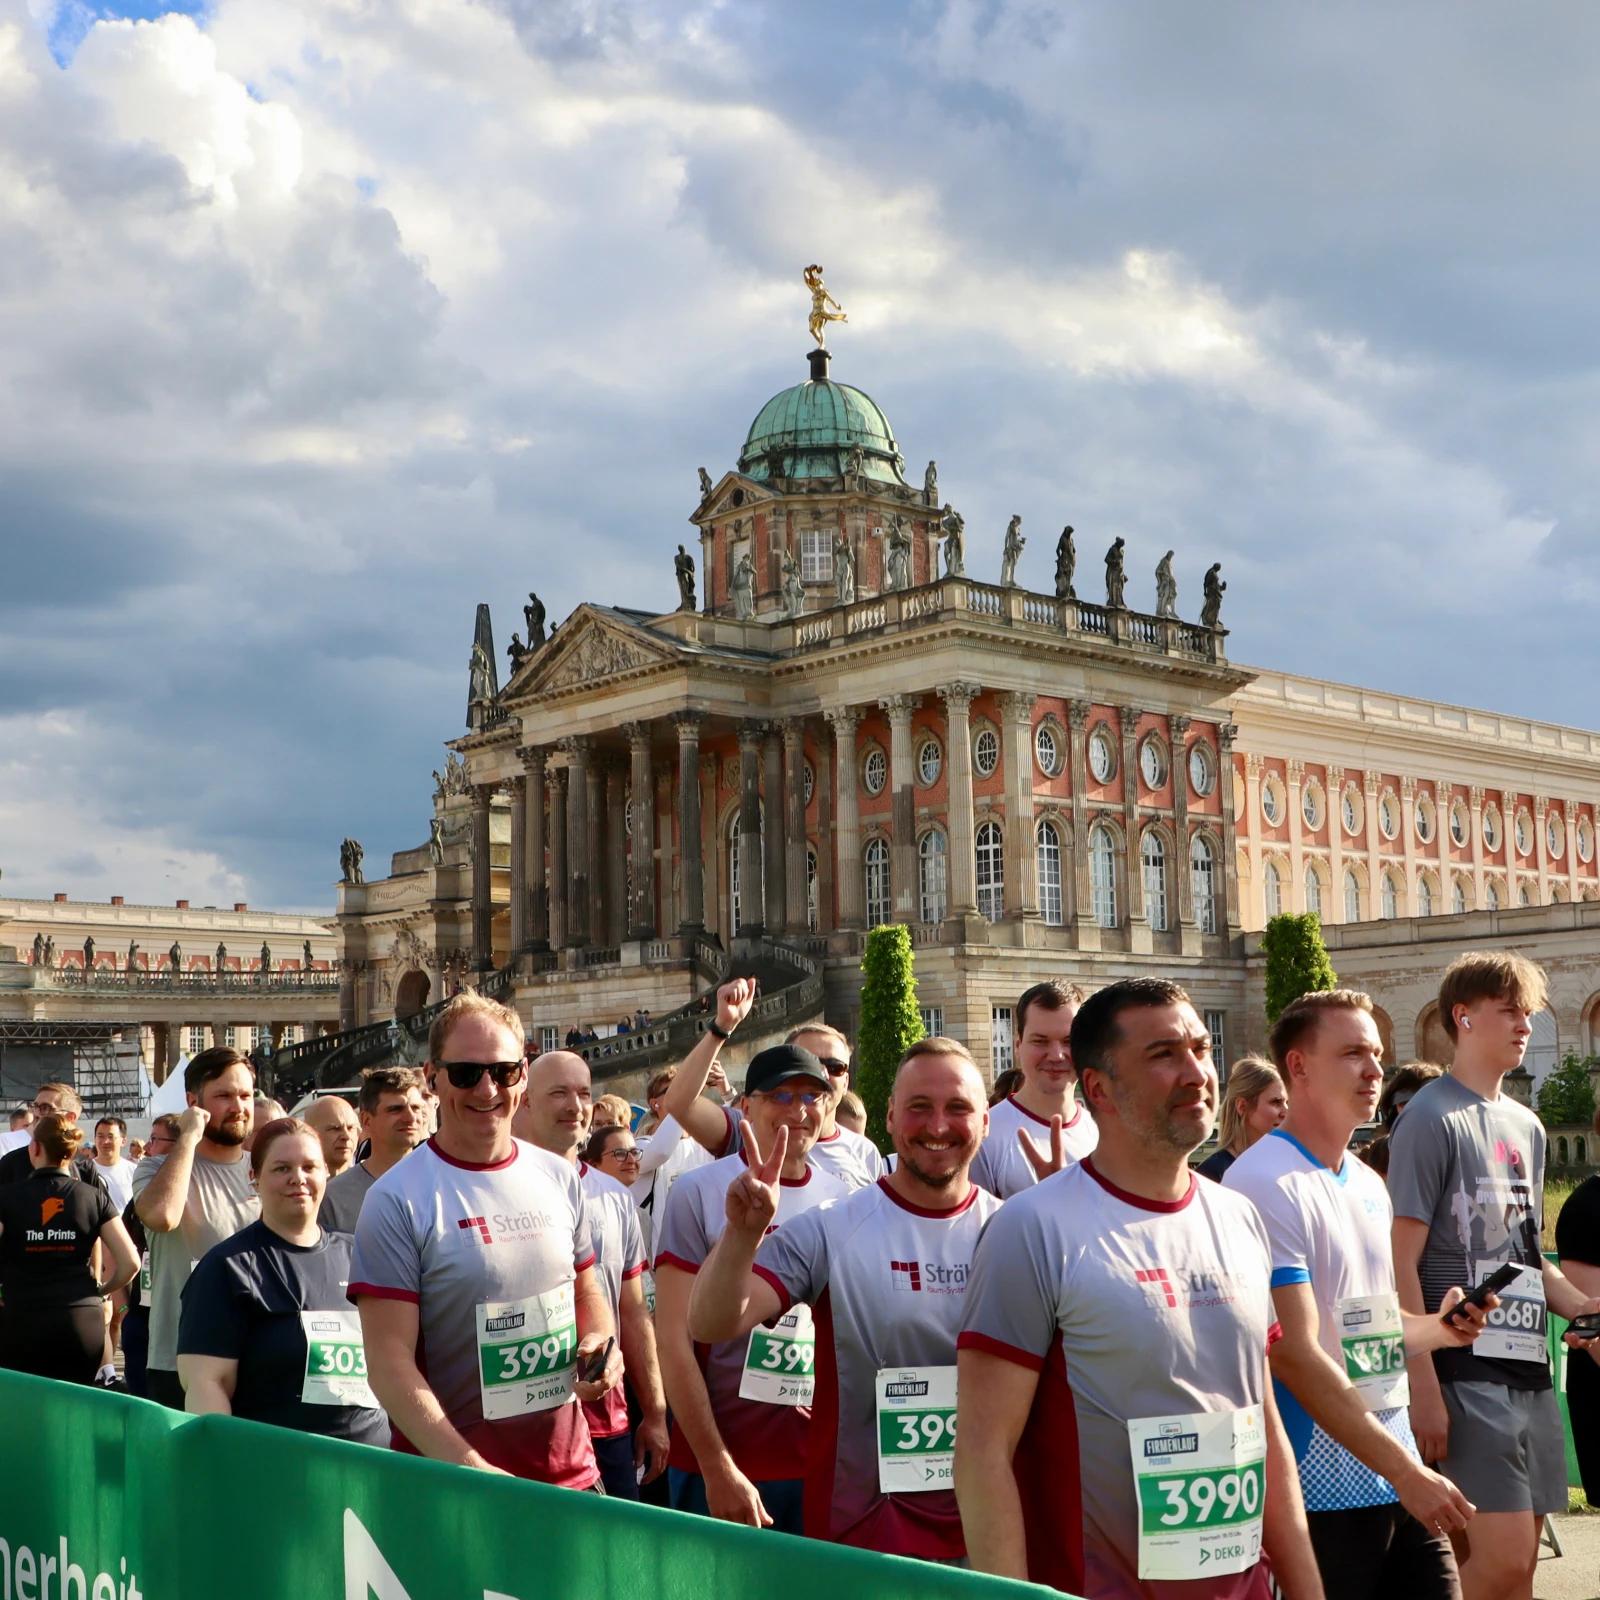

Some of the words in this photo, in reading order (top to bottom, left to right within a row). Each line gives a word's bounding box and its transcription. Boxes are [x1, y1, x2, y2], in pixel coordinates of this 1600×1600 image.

[493, 1210, 555, 1233] Strähle
[26, 1230, 44, 1241] The
[47, 1229, 76, 1240] Prints
[488, 1314, 524, 1331] FIRMENLAUF
[1488, 1300, 1541, 1330] 6687
[499, 1331, 571, 1379] 3997
[538, 1385, 566, 1400] DEKRA
[888, 1383, 927, 1396] FIRMENLAUF
[1146, 1436, 1197, 1454] FIRMENLAUF
[1158, 1470, 1258, 1525] 3990
